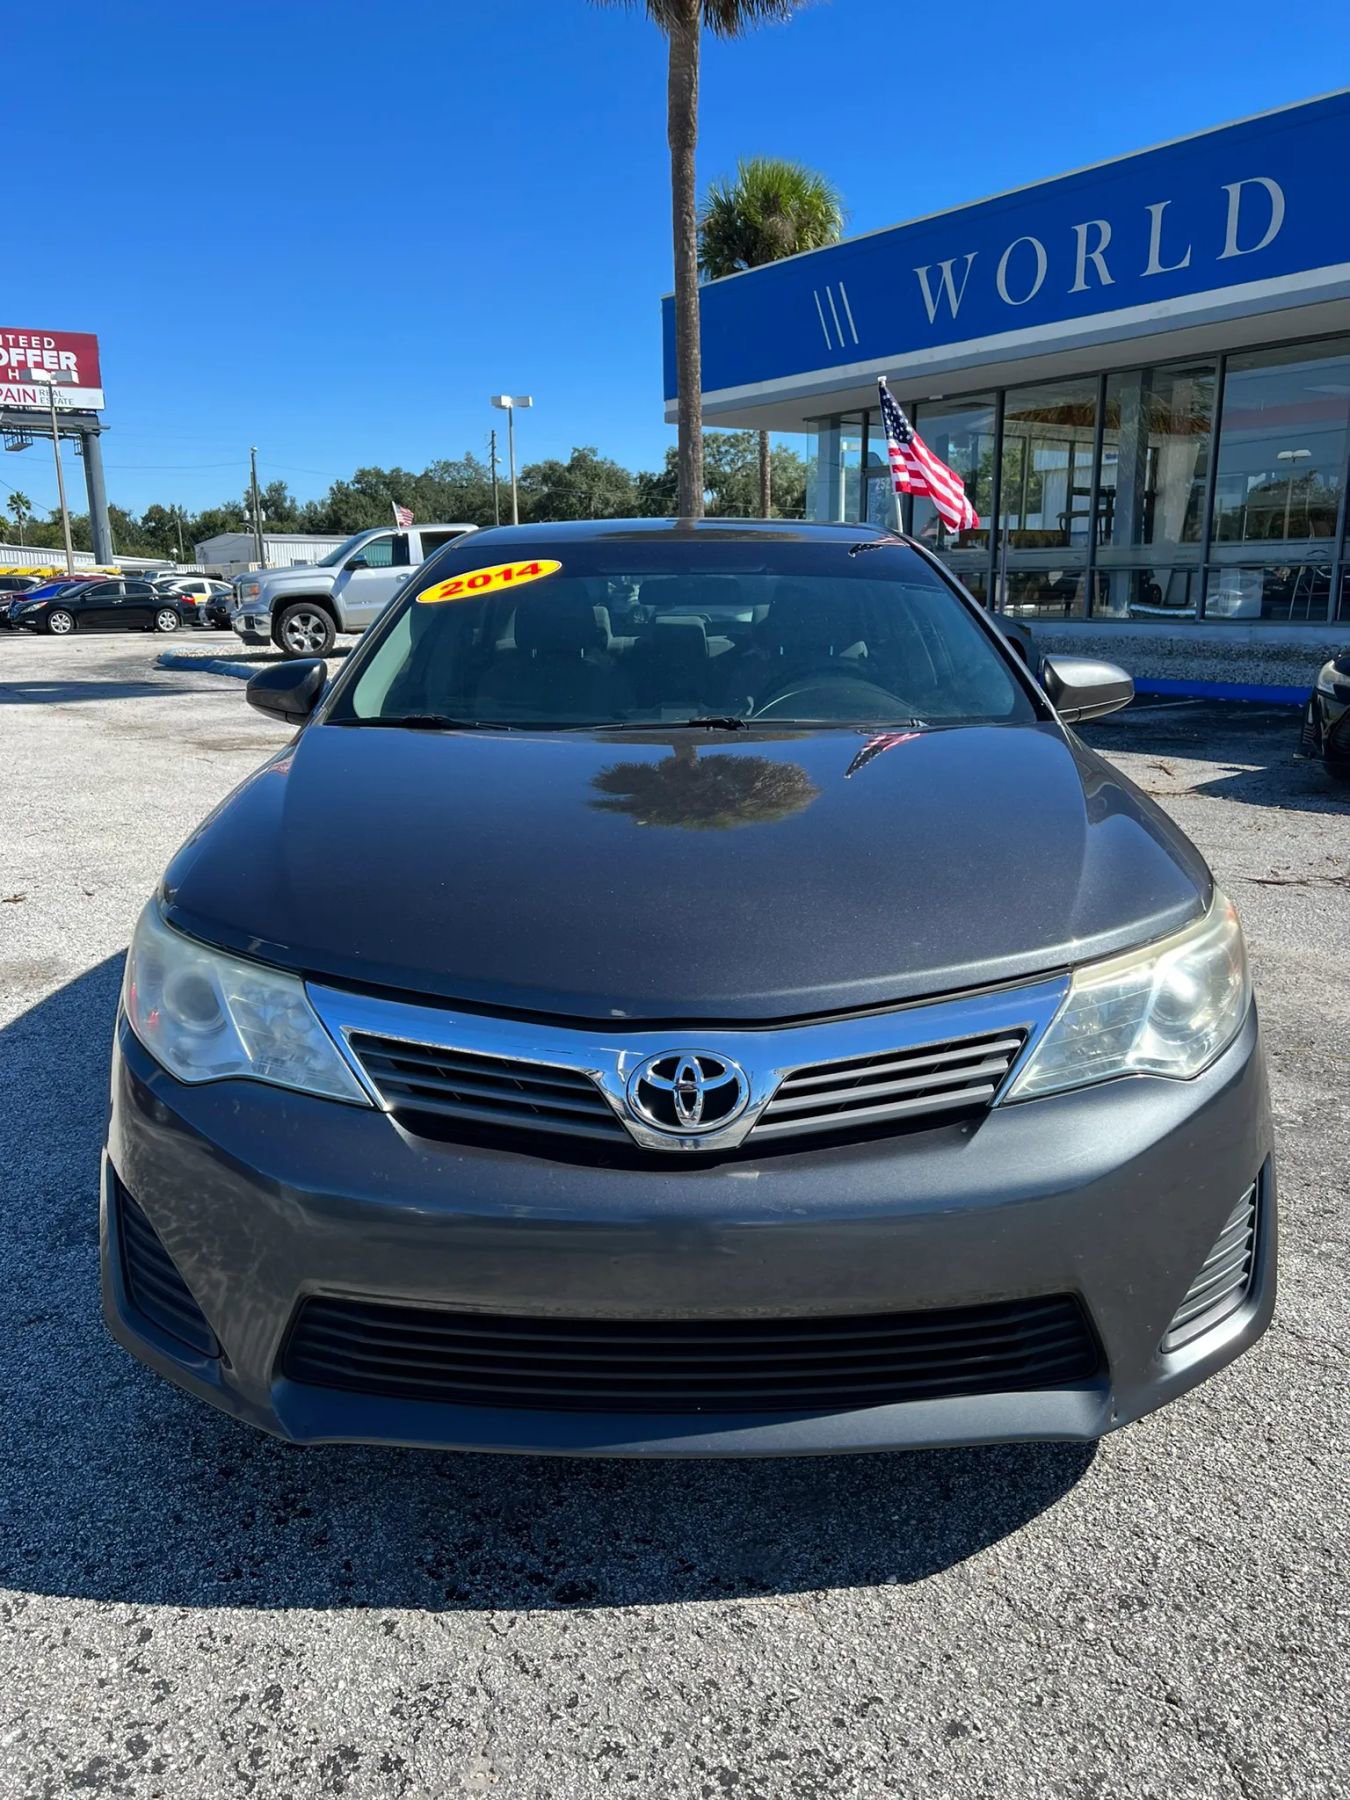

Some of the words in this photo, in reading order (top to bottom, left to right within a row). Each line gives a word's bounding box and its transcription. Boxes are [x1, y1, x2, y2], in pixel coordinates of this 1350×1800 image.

[912, 176, 1286, 325] WORLD
[0, 334, 55, 349] TEED
[0, 387, 37, 404] AIN
[39, 388, 63, 398] REAL
[438, 562, 543, 599] 2014
